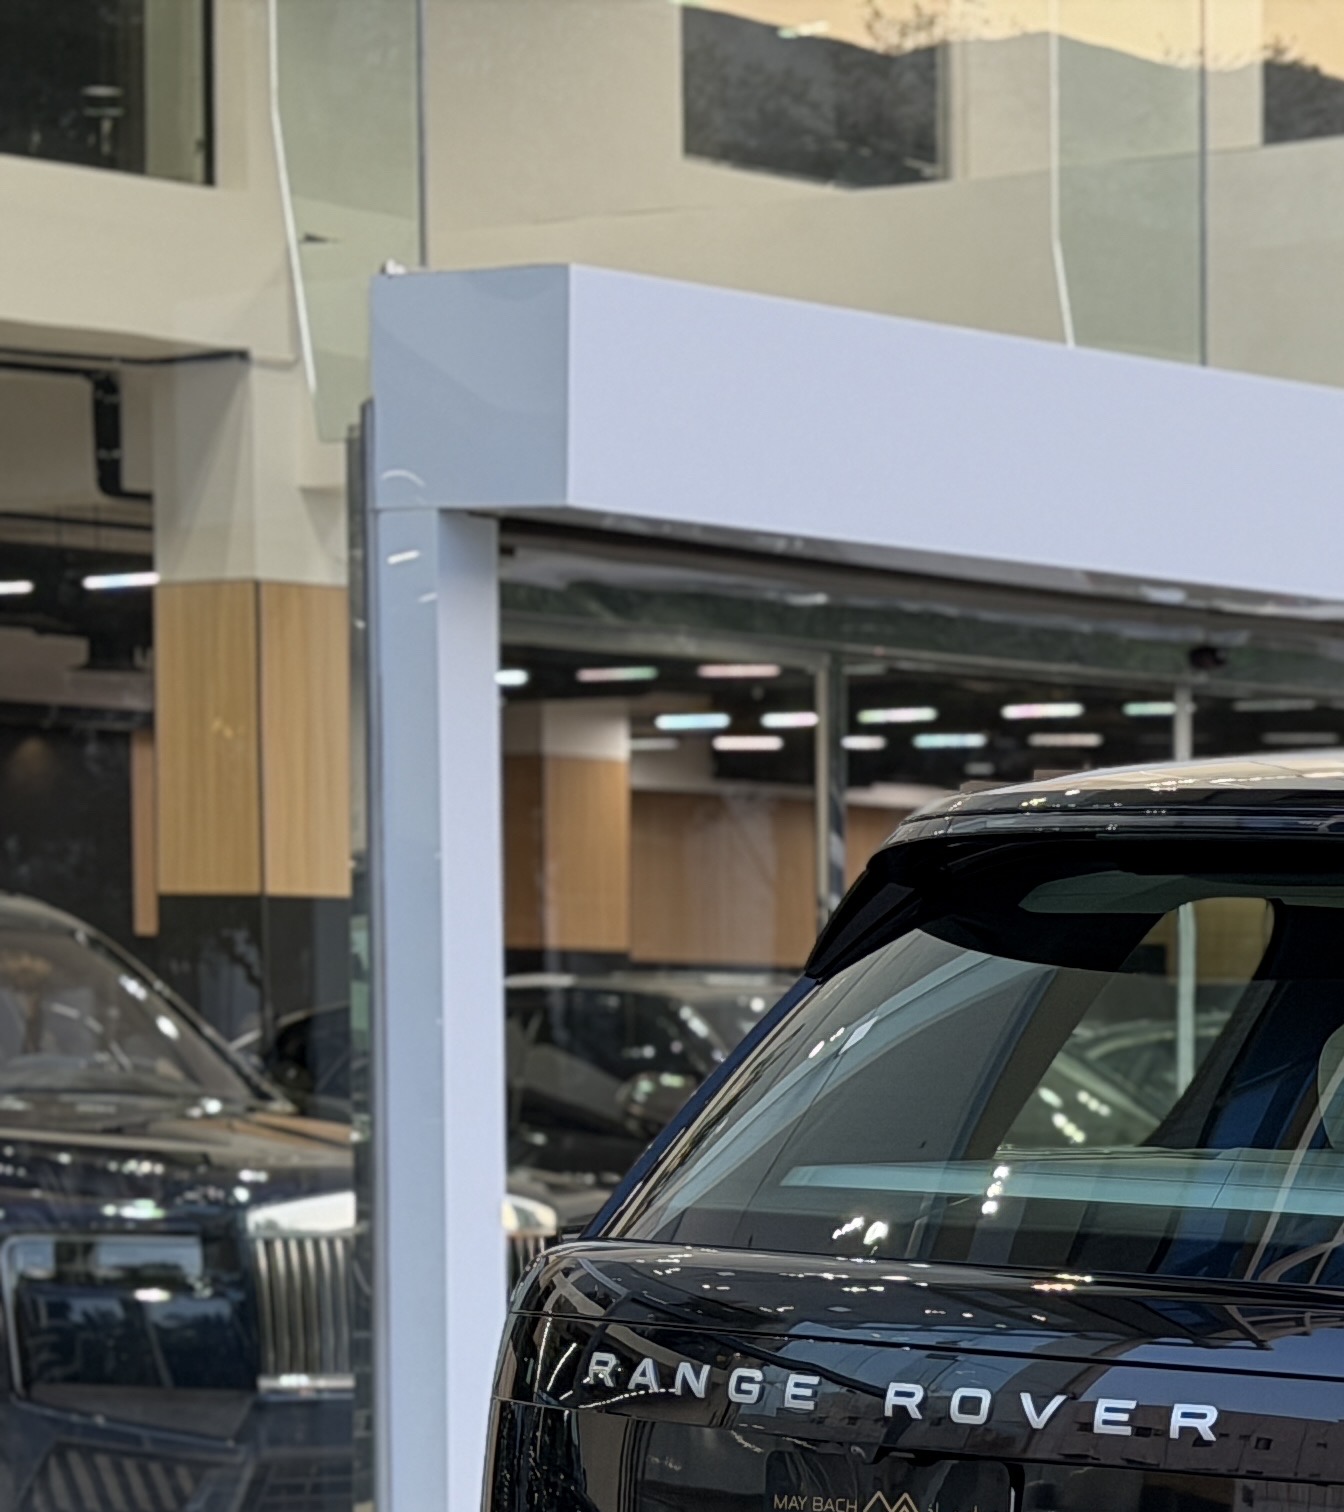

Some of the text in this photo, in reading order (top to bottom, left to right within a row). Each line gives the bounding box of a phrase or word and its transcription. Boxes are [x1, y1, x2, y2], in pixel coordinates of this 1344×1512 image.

[587, 1352, 1219, 1442] RANGE ROVER
[773, 1493, 808, 1511] MAY
